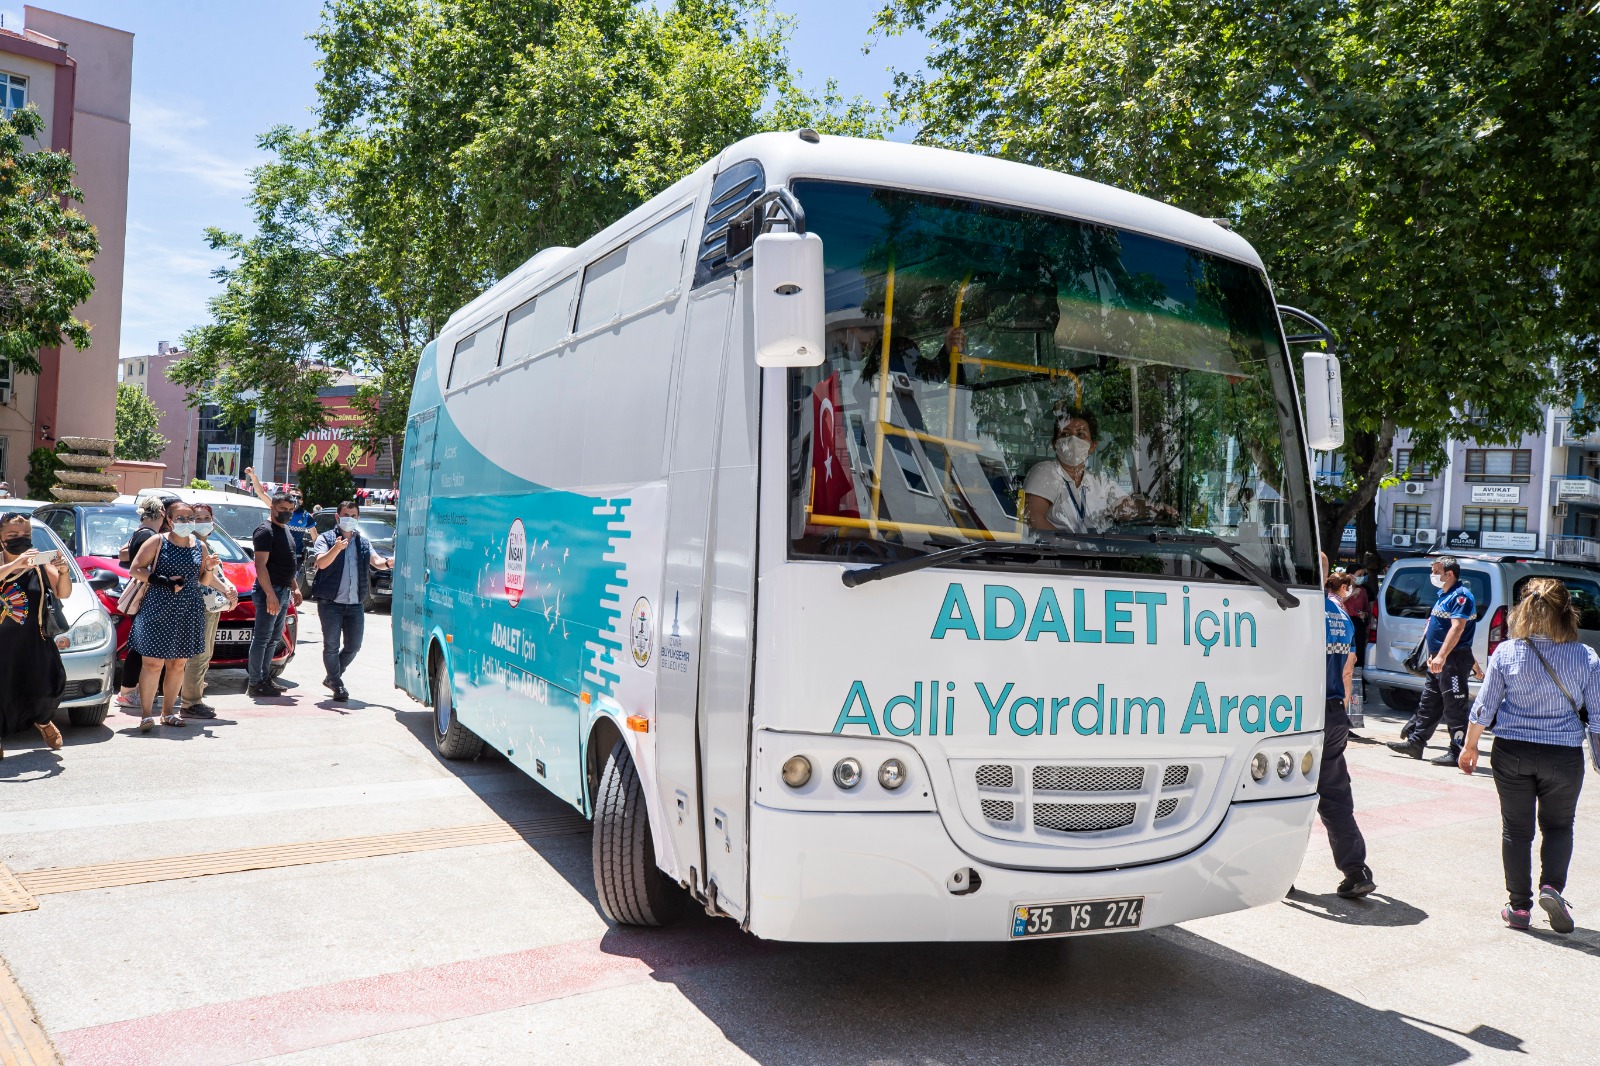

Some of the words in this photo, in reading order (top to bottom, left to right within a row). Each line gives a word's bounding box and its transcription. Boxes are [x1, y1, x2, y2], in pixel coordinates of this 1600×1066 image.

[214, 630, 232, 640] EBA
[930, 583, 1167, 645] ADALET
[1183, 585, 1257, 657] İçin
[491, 622, 521, 655] ADALET
[522, 628, 536, 663] İçin
[520, 672, 548, 706] ARACI
[831, 680, 956, 737] Adli
[974, 681, 1165, 737] Yardım
[1180, 681, 1303, 734] Aracı
[1028, 908, 1053, 933] 35
[1070, 905, 1092, 930] YS
[1104, 901, 1138, 927] 274
